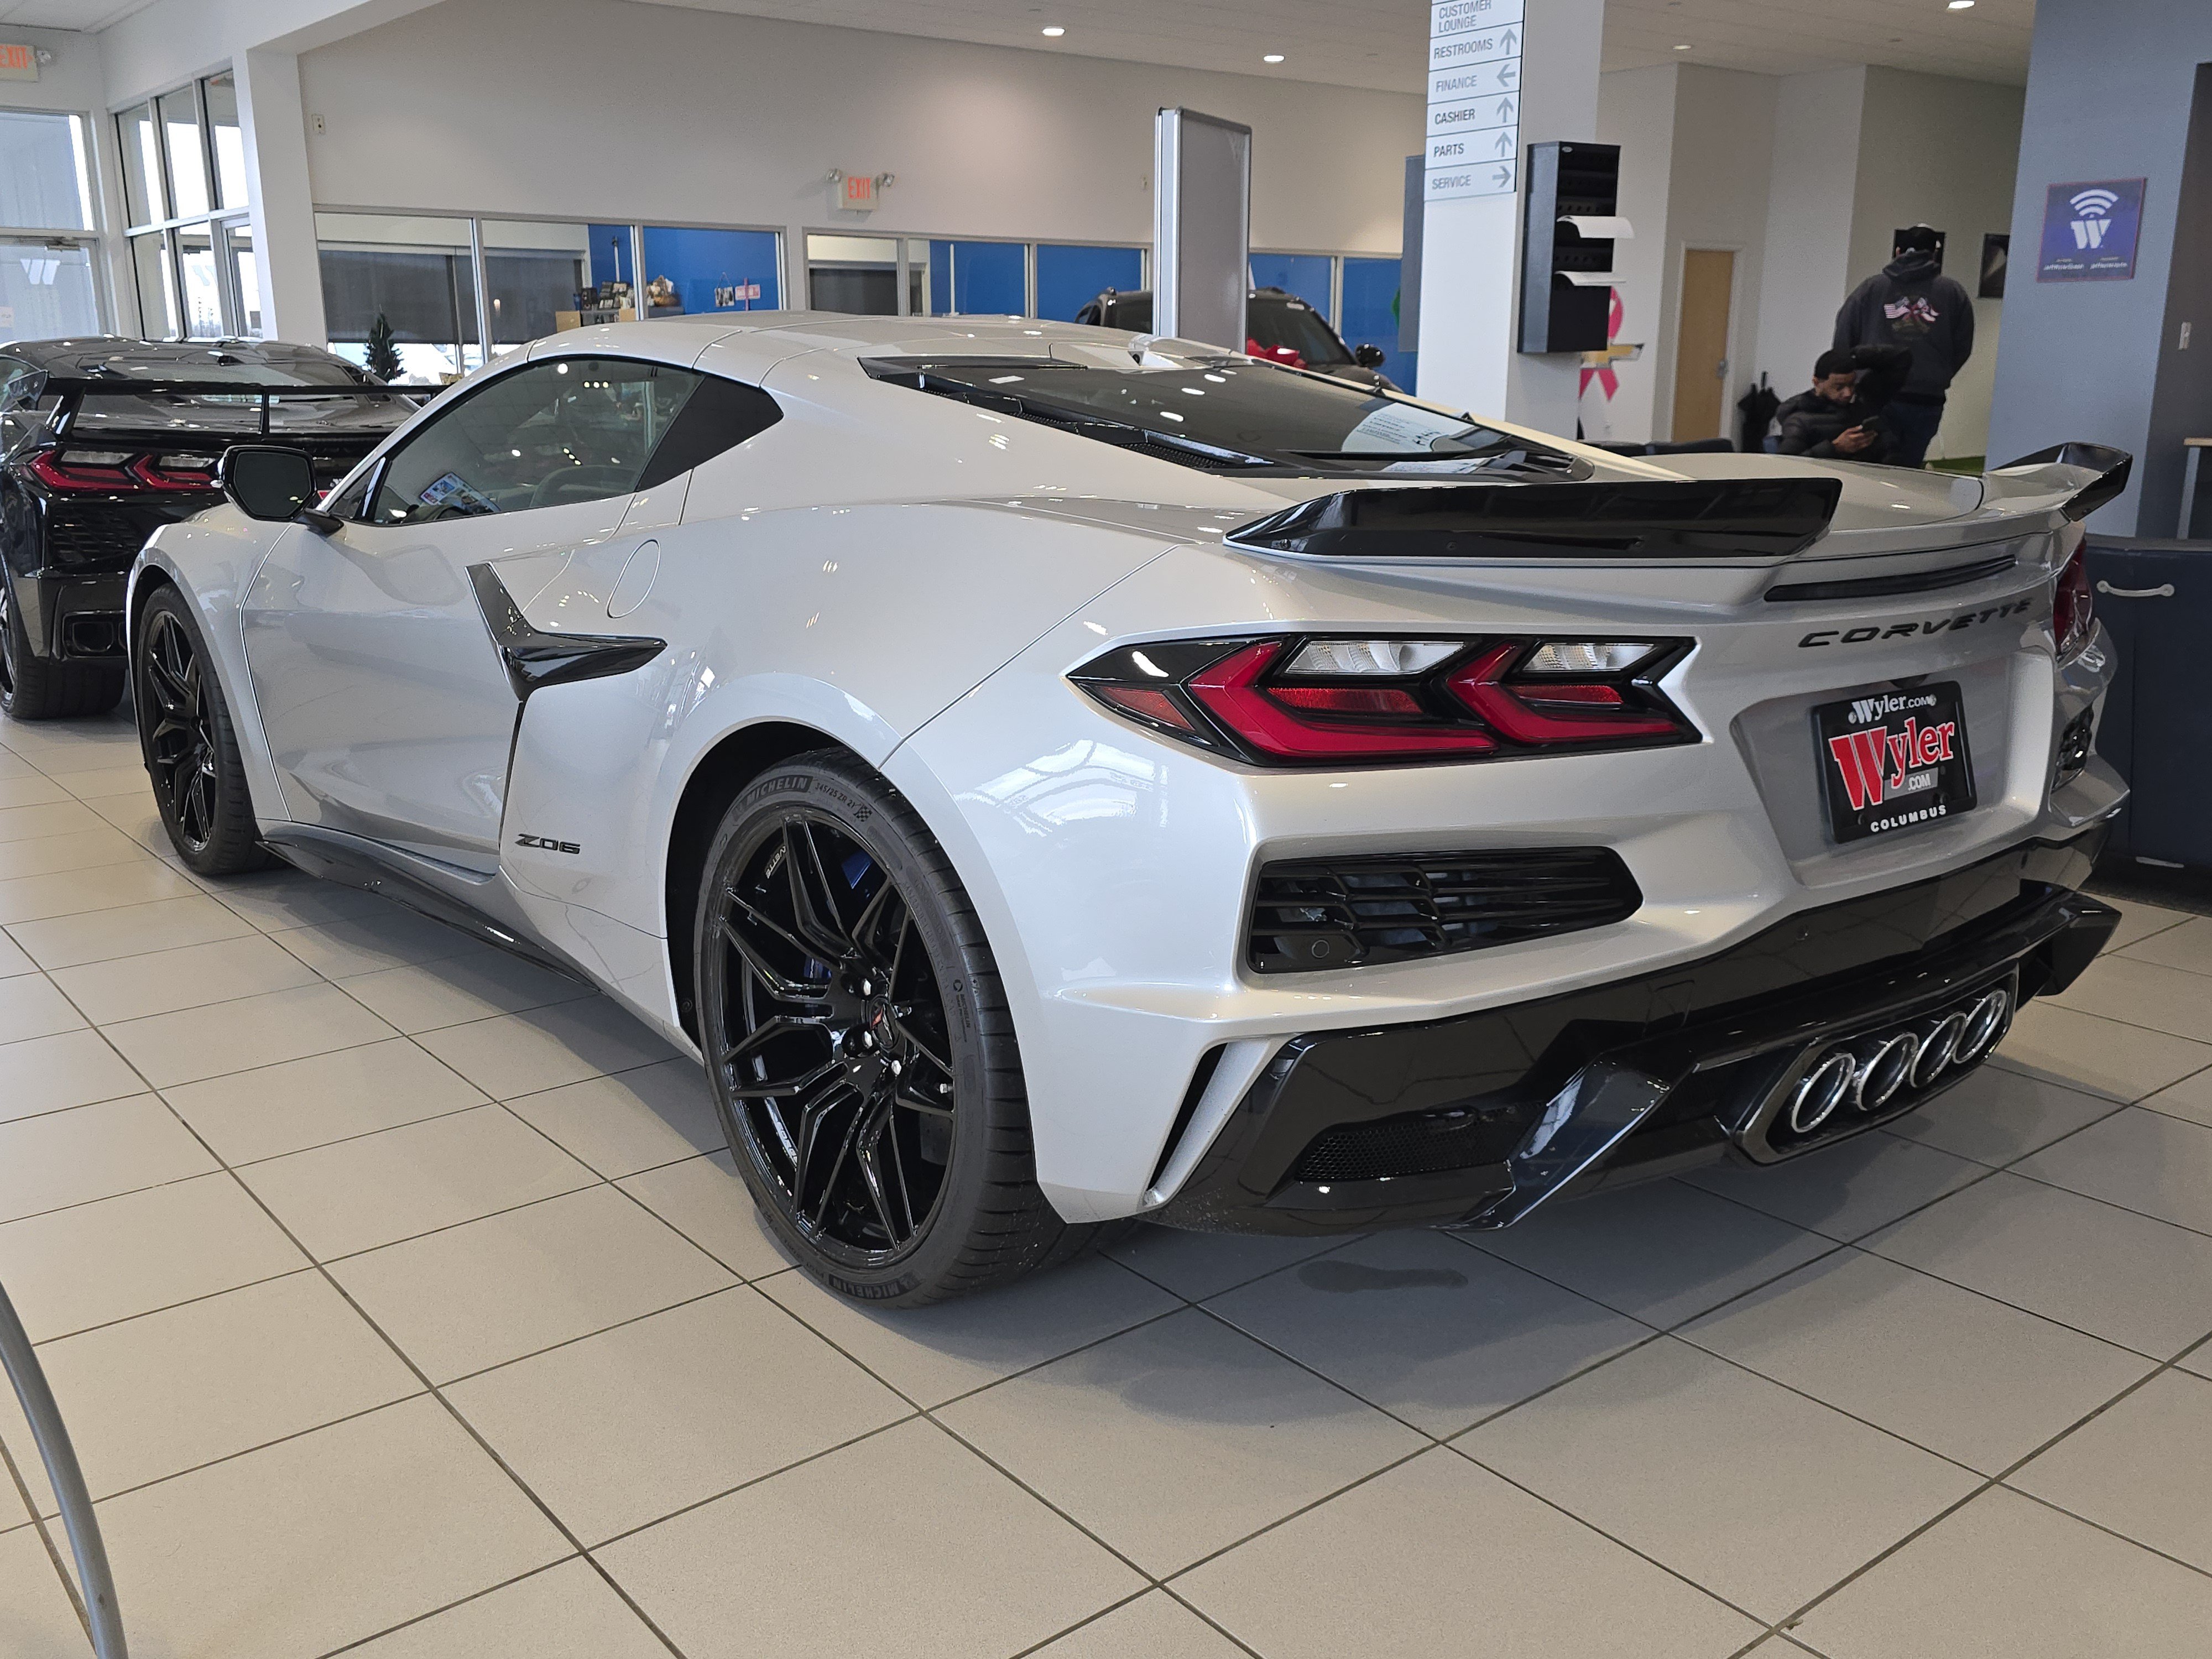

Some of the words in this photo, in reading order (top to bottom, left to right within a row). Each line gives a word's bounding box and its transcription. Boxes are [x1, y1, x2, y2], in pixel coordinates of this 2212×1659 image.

[1439, 0, 1491, 19] CUSTOMER
[1438, 15, 1477, 33] LOUNGE
[1434, 38, 1493, 59] RESTROOMS
[1436, 75, 1478, 92] FINANCE
[1435, 108, 1475, 125] CASHIER
[1433, 143, 1464, 158] PARTS
[848, 177, 870, 199] EXIT
[1432, 175, 1472, 190] SERVICE
[1798, 597, 2033, 648] CORVETTE
[1828, 717, 1955, 811] Wyler
[747, 777, 808, 804] MICHELIN
[815, 782, 838, 797] 345/25
[1870, 805, 1947, 832] COLUMBUS
[514, 833, 580, 854] Z06
[832, 1277, 900, 1298] MICHELIN
